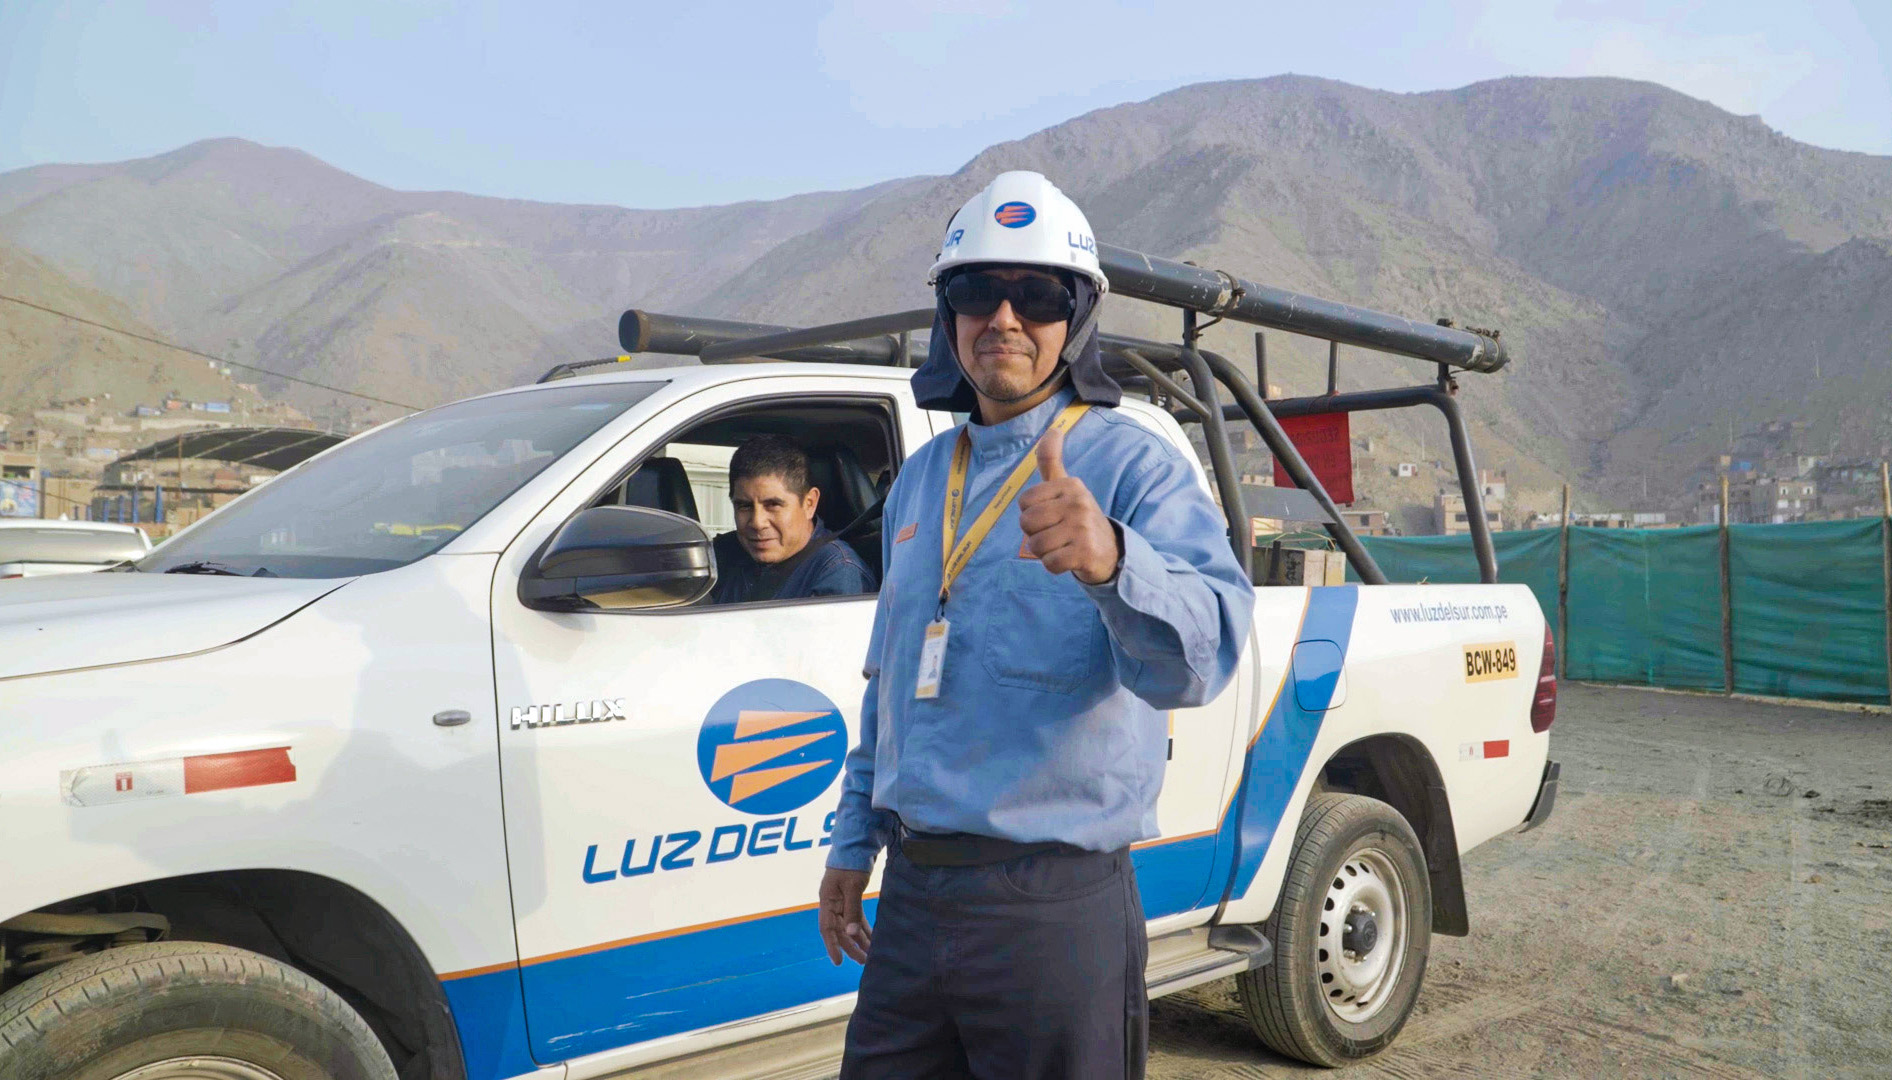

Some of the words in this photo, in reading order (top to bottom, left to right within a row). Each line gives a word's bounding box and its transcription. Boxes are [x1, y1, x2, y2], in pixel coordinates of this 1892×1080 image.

[944, 229, 965, 247] UR
[1067, 231, 1095, 254] LUZ
[1390, 602, 1508, 623] www.luzdelsur.com.pe
[1466, 648, 1516, 677] BCW-849
[511, 699, 626, 730] HILUX
[582, 830, 702, 884] LUZ
[706, 816, 813, 864] DEL
